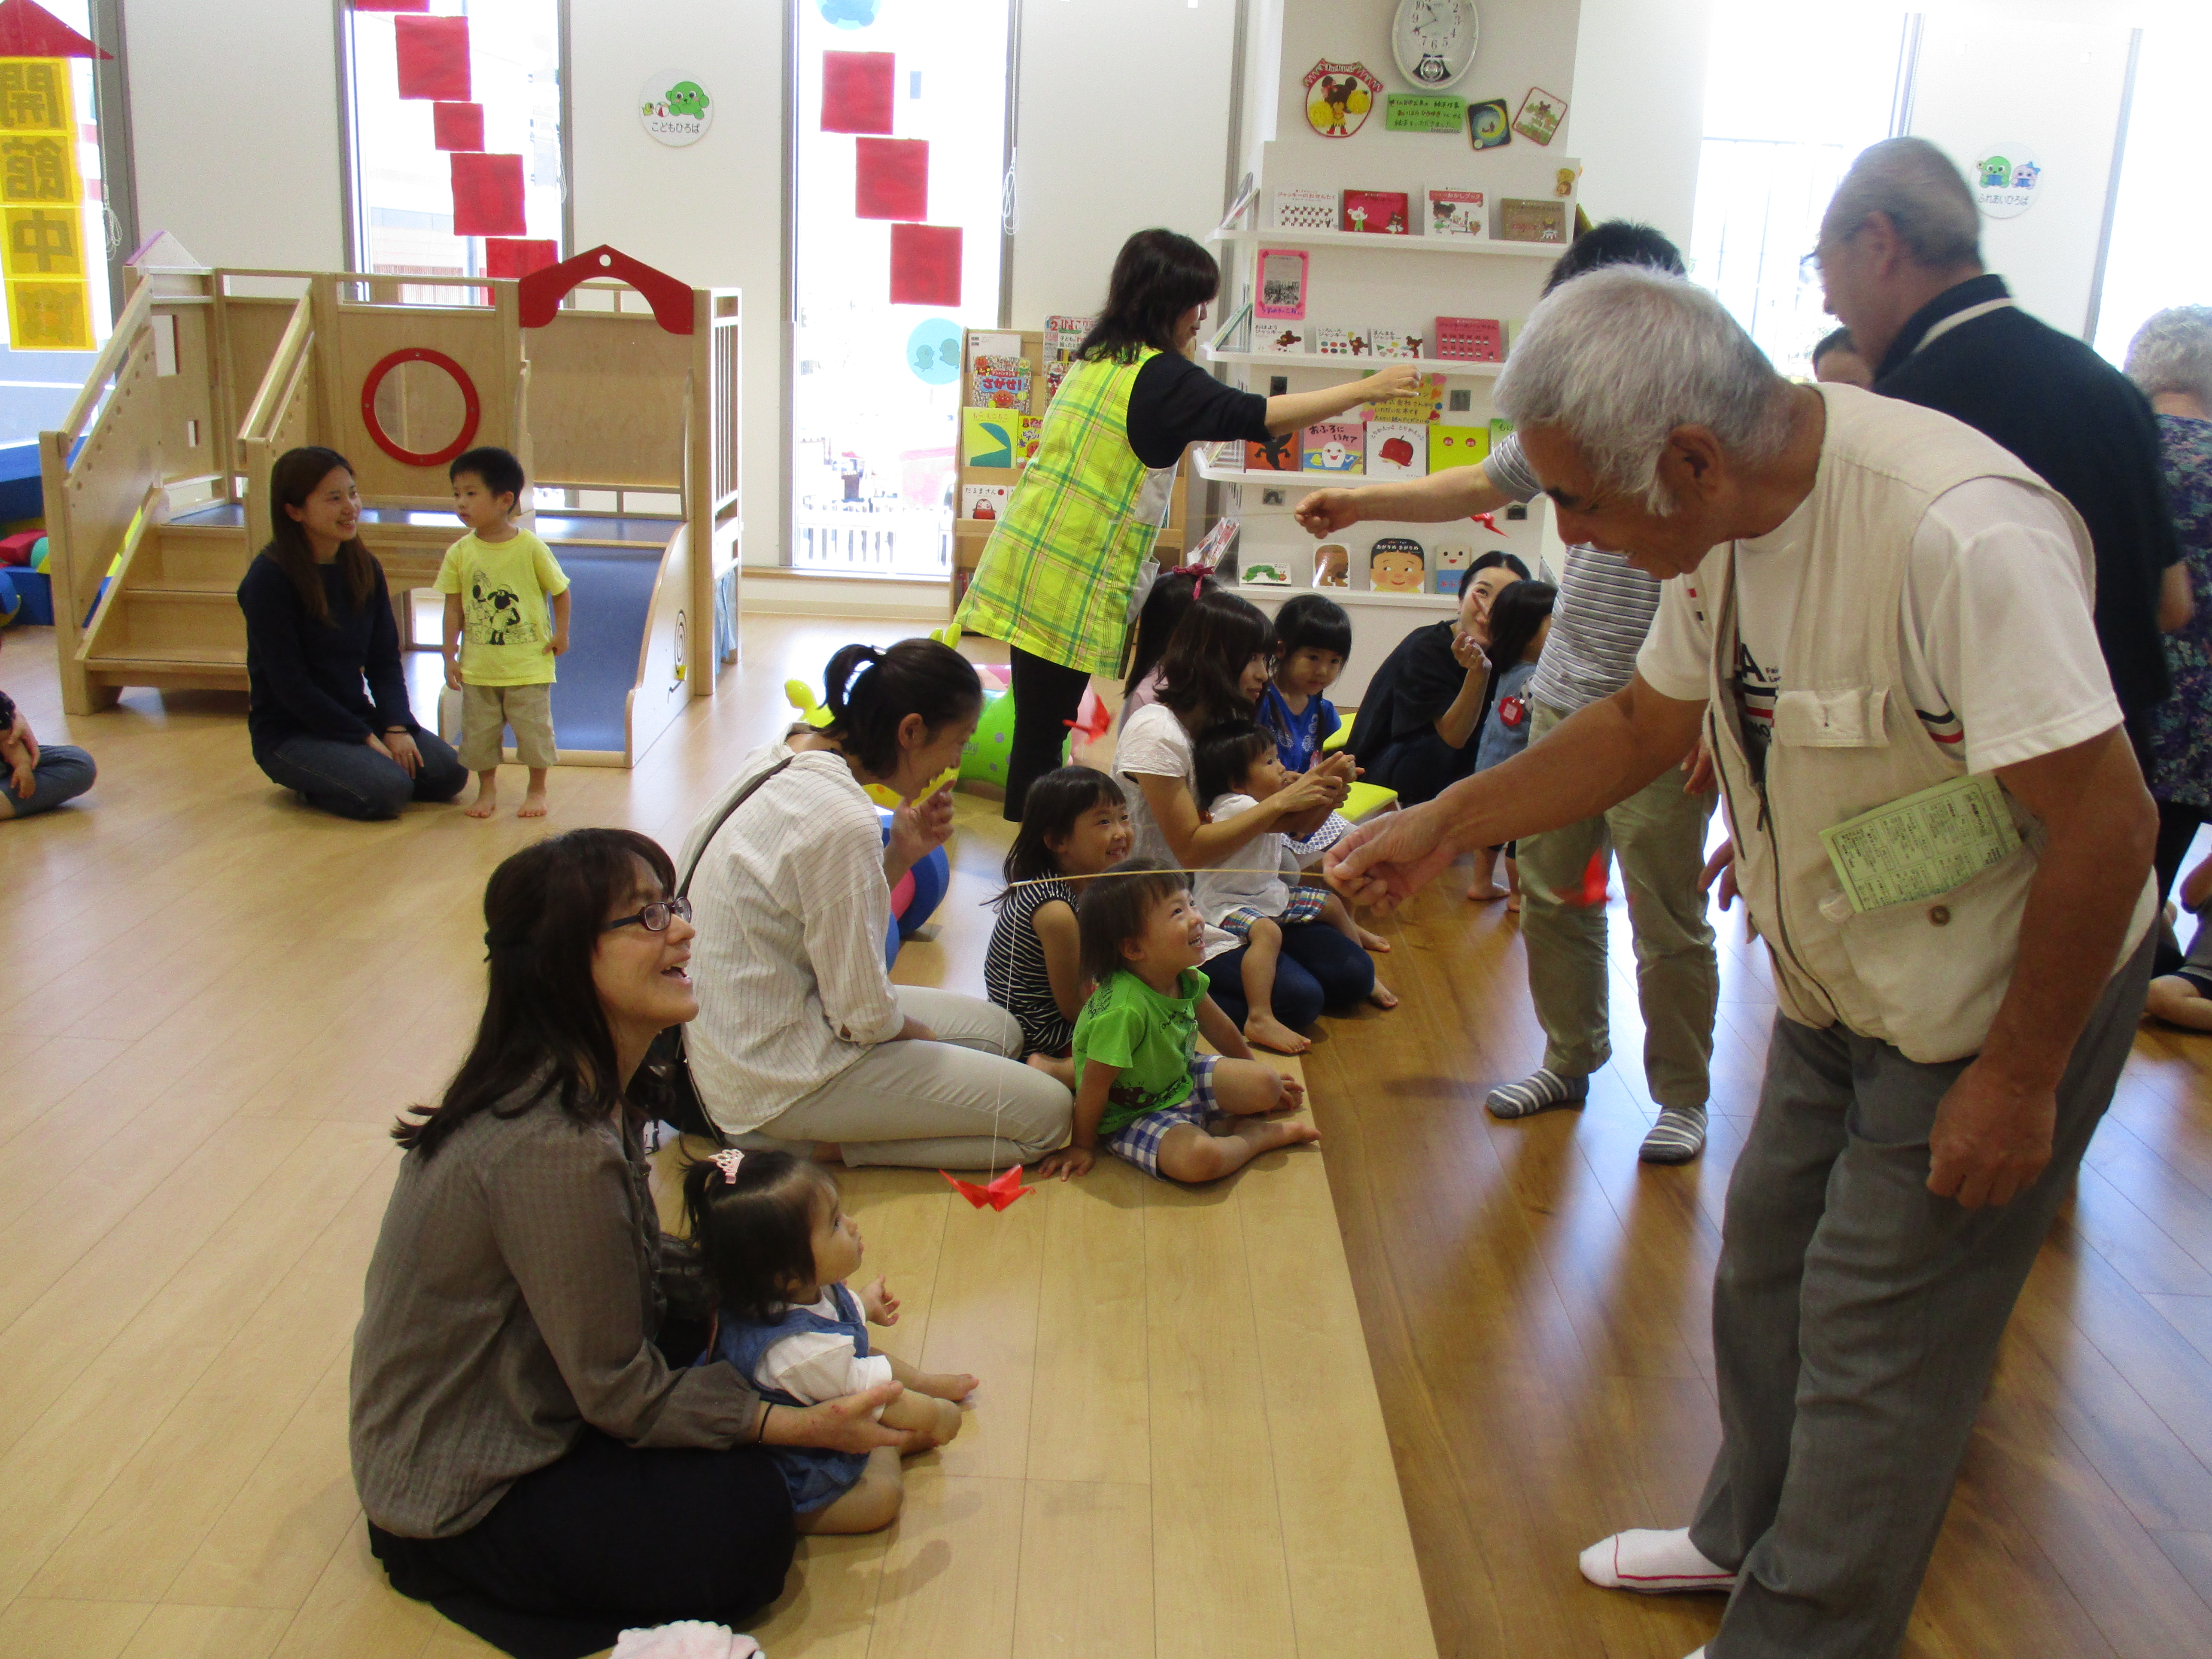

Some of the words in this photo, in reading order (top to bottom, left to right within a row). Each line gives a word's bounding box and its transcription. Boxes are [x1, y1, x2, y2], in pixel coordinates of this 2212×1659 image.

[1453, 3, 1458, 12] 2
[1422, 36, 1427, 46] 7
[1431, 39, 1437, 50] 6
[1443, 37, 1448, 47] 5
[651, 122, 700, 134] こどもひろば
[982, 378, 1022, 390] さがせ!
[1310, 425, 1344, 434] おふろに
[1334, 434, 1358, 443] いれて
[966, 487, 996, 495] だるまさん
